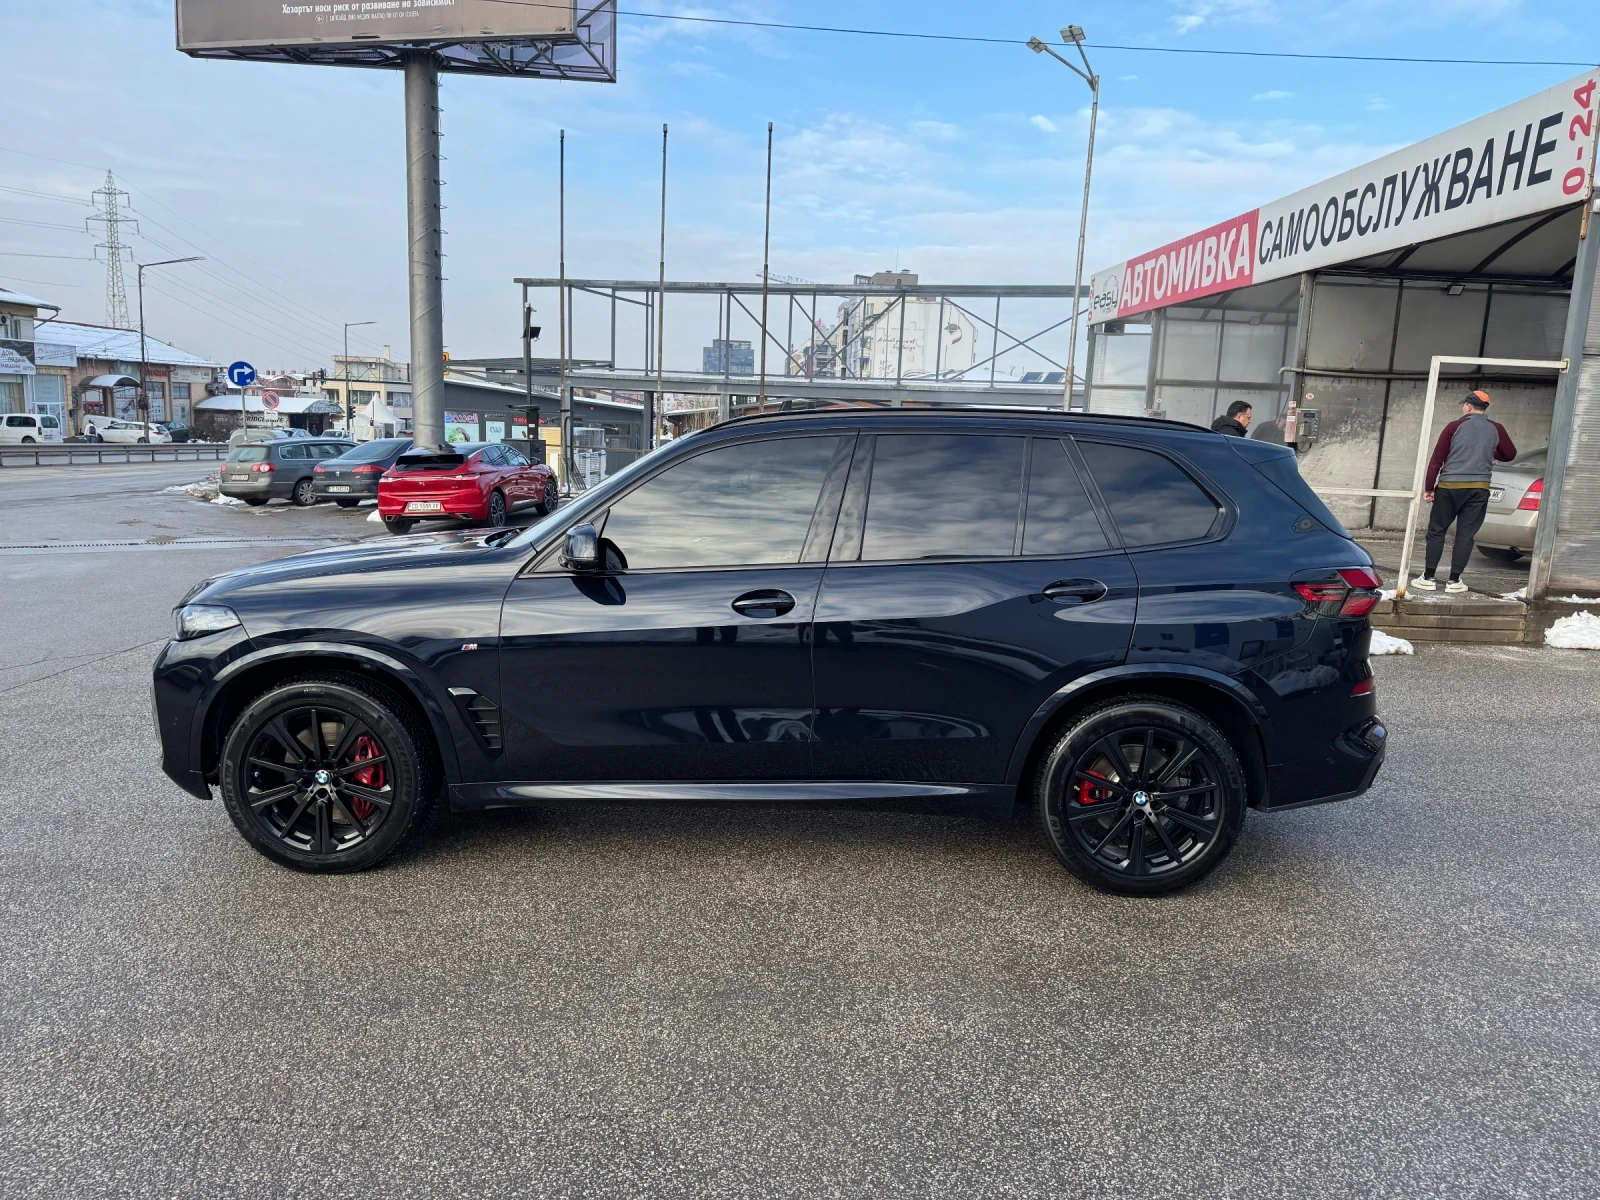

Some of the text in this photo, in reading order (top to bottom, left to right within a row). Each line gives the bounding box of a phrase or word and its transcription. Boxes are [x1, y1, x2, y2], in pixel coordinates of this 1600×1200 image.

[282, 0, 455, 16] Хазартът носи риск от развиване на зависимост
[1562, 79, 1597, 195] 0-24
[1258, 111, 1564, 265] САМООБСЛУЖВАНЕ
[1120, 222, 1250, 310] АВТОМИВКА
[1093, 289, 1118, 310] easy
[1, 349, 14, 357] ДОМ
